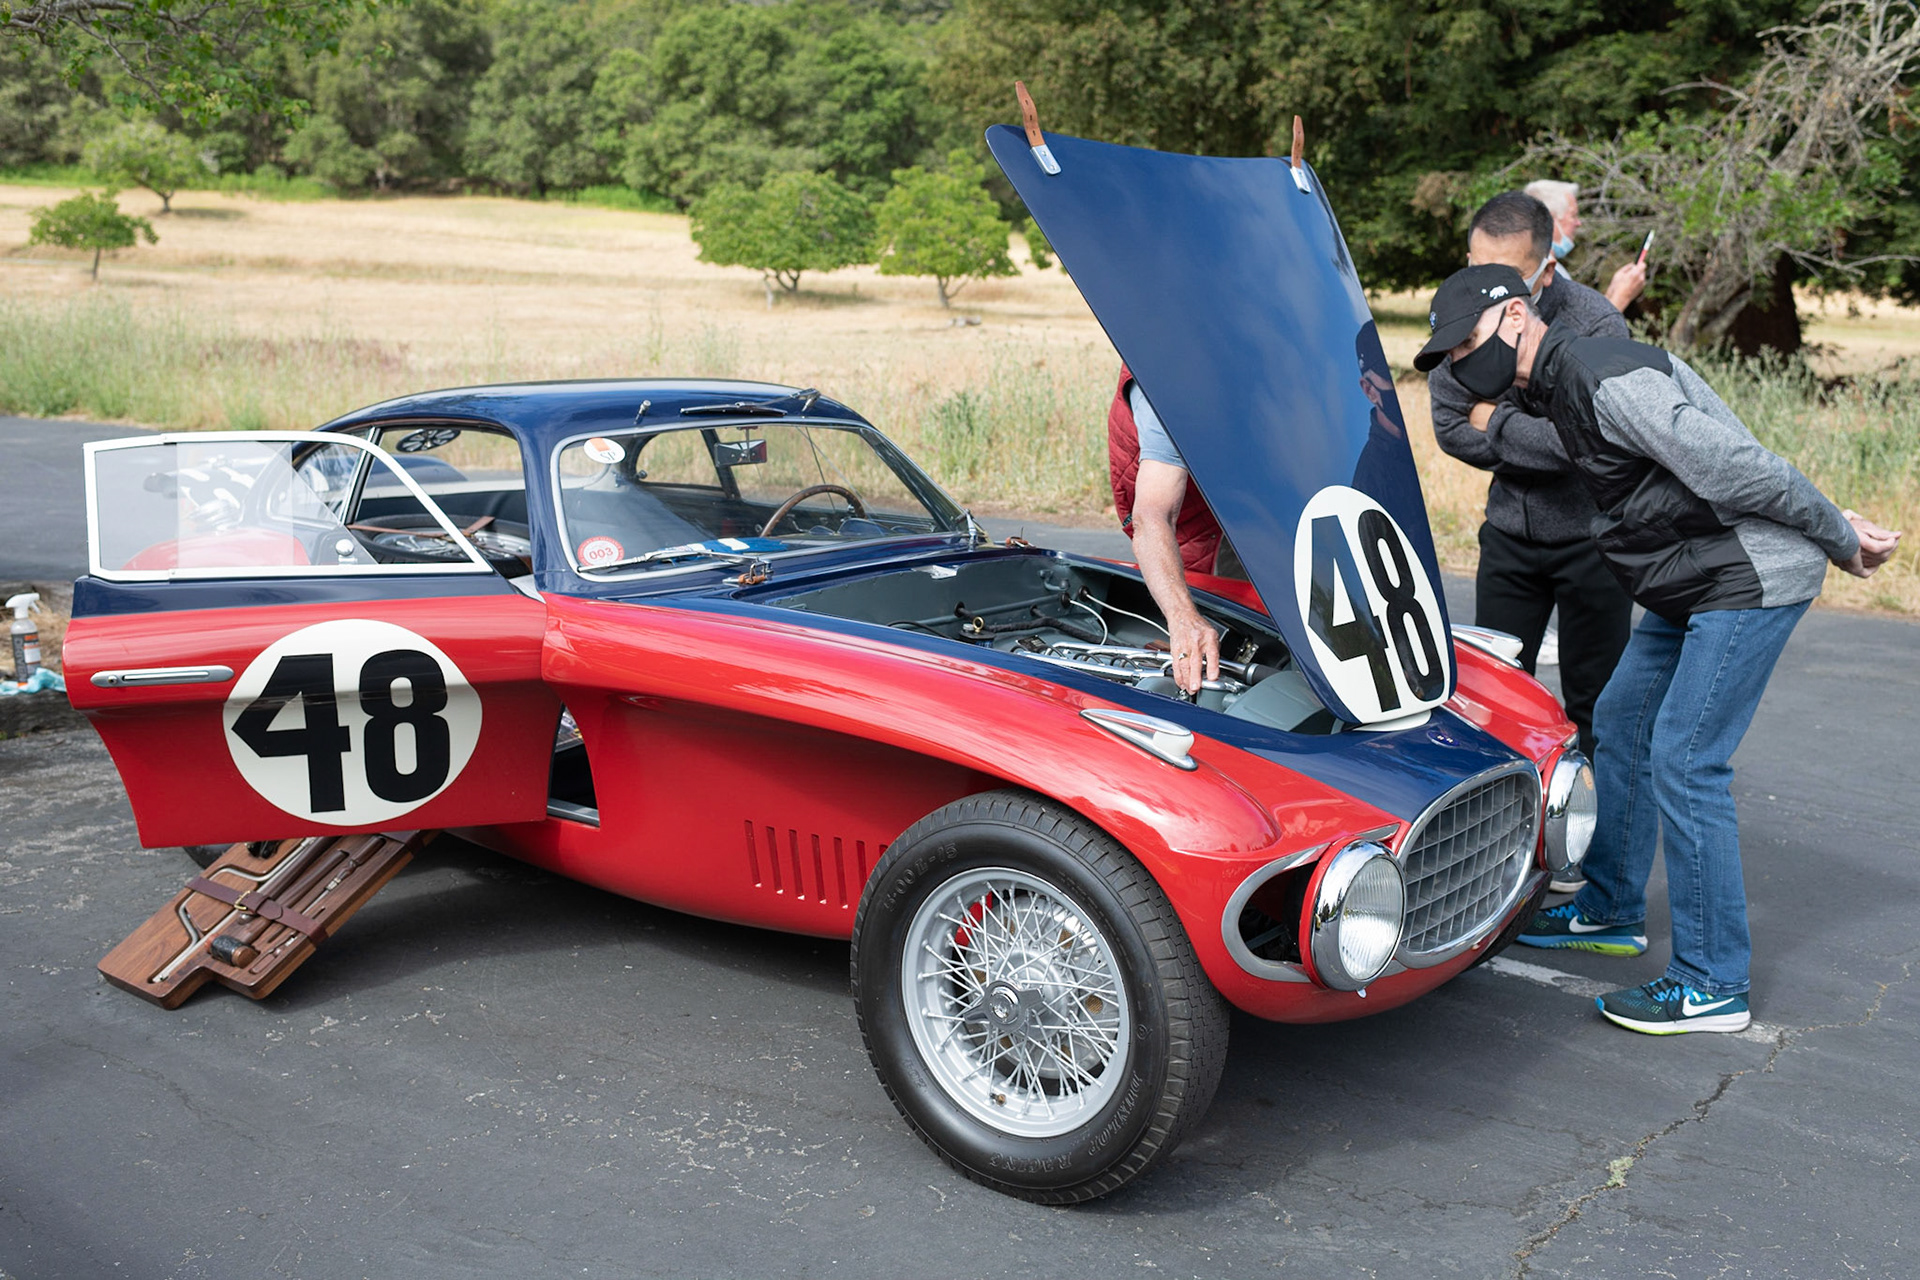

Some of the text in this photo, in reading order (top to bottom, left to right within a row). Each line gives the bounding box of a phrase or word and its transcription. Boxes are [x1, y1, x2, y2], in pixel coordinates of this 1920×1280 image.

[589, 547, 613, 560] 003
[1308, 509, 1445, 713] 48
[231, 649, 450, 813] 48
